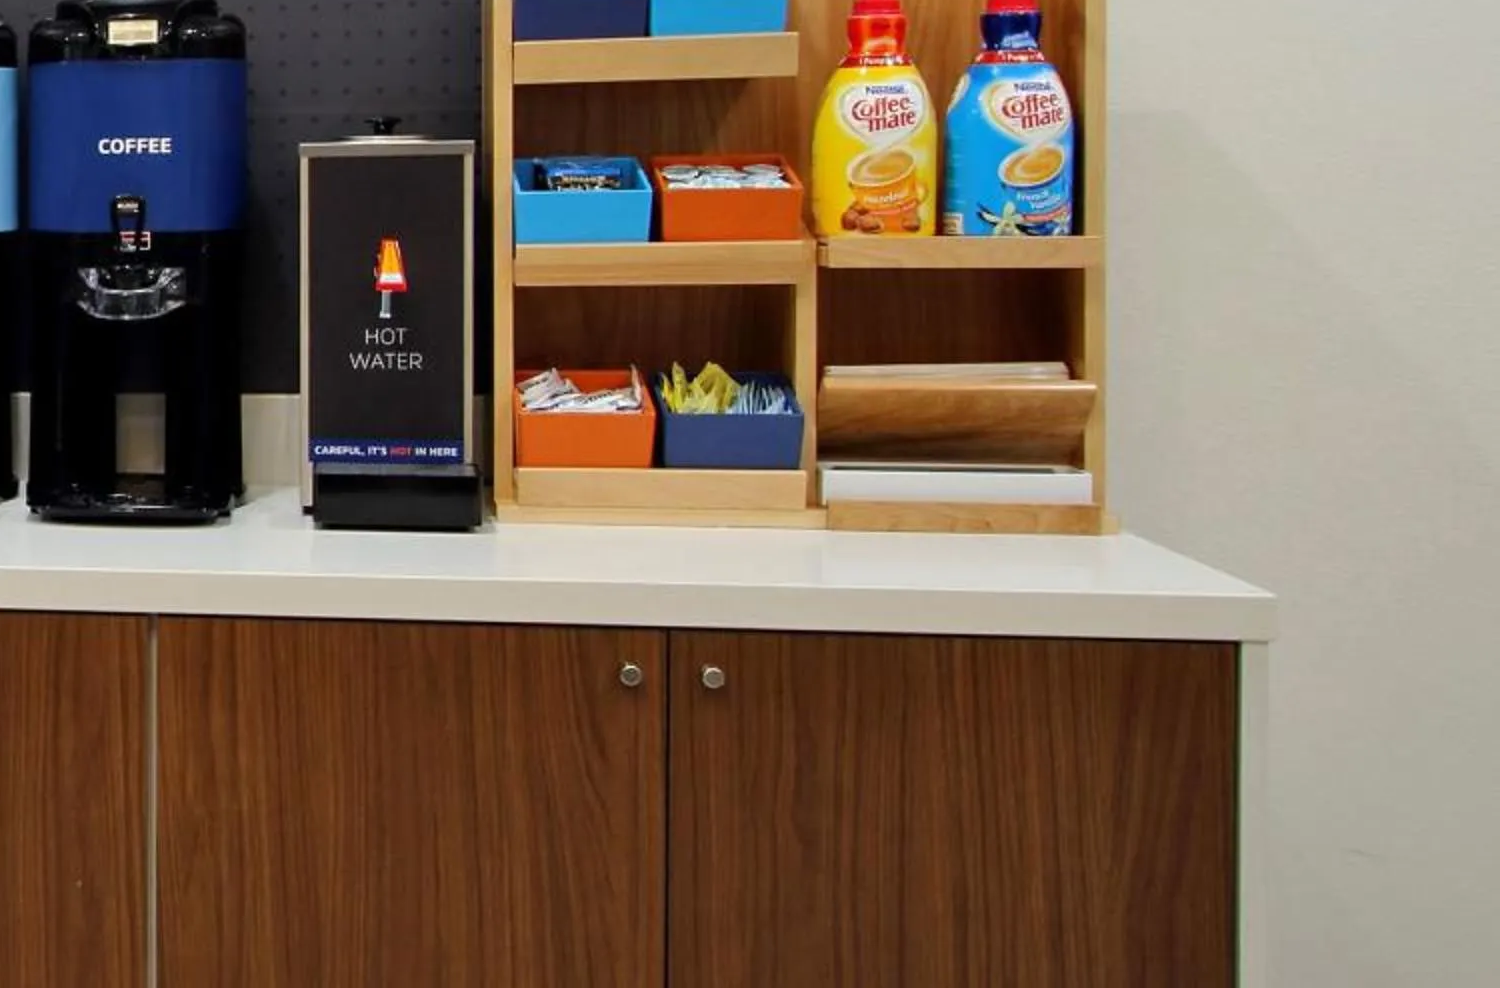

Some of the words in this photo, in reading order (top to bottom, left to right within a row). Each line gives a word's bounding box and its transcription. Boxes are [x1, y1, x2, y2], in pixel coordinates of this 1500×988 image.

[852, 96, 913, 121] Coffee
[1002, 93, 1061, 118] Coffee
[868, 111, 917, 132] mate
[1021, 107, 1065, 129] mate
[98, 137, 173, 154] COFFEE
[365, 327, 408, 345] HOT
[349, 352, 423, 370] WATER
[415, 447, 427, 457] IN
[429, 447, 458, 457] HERE
